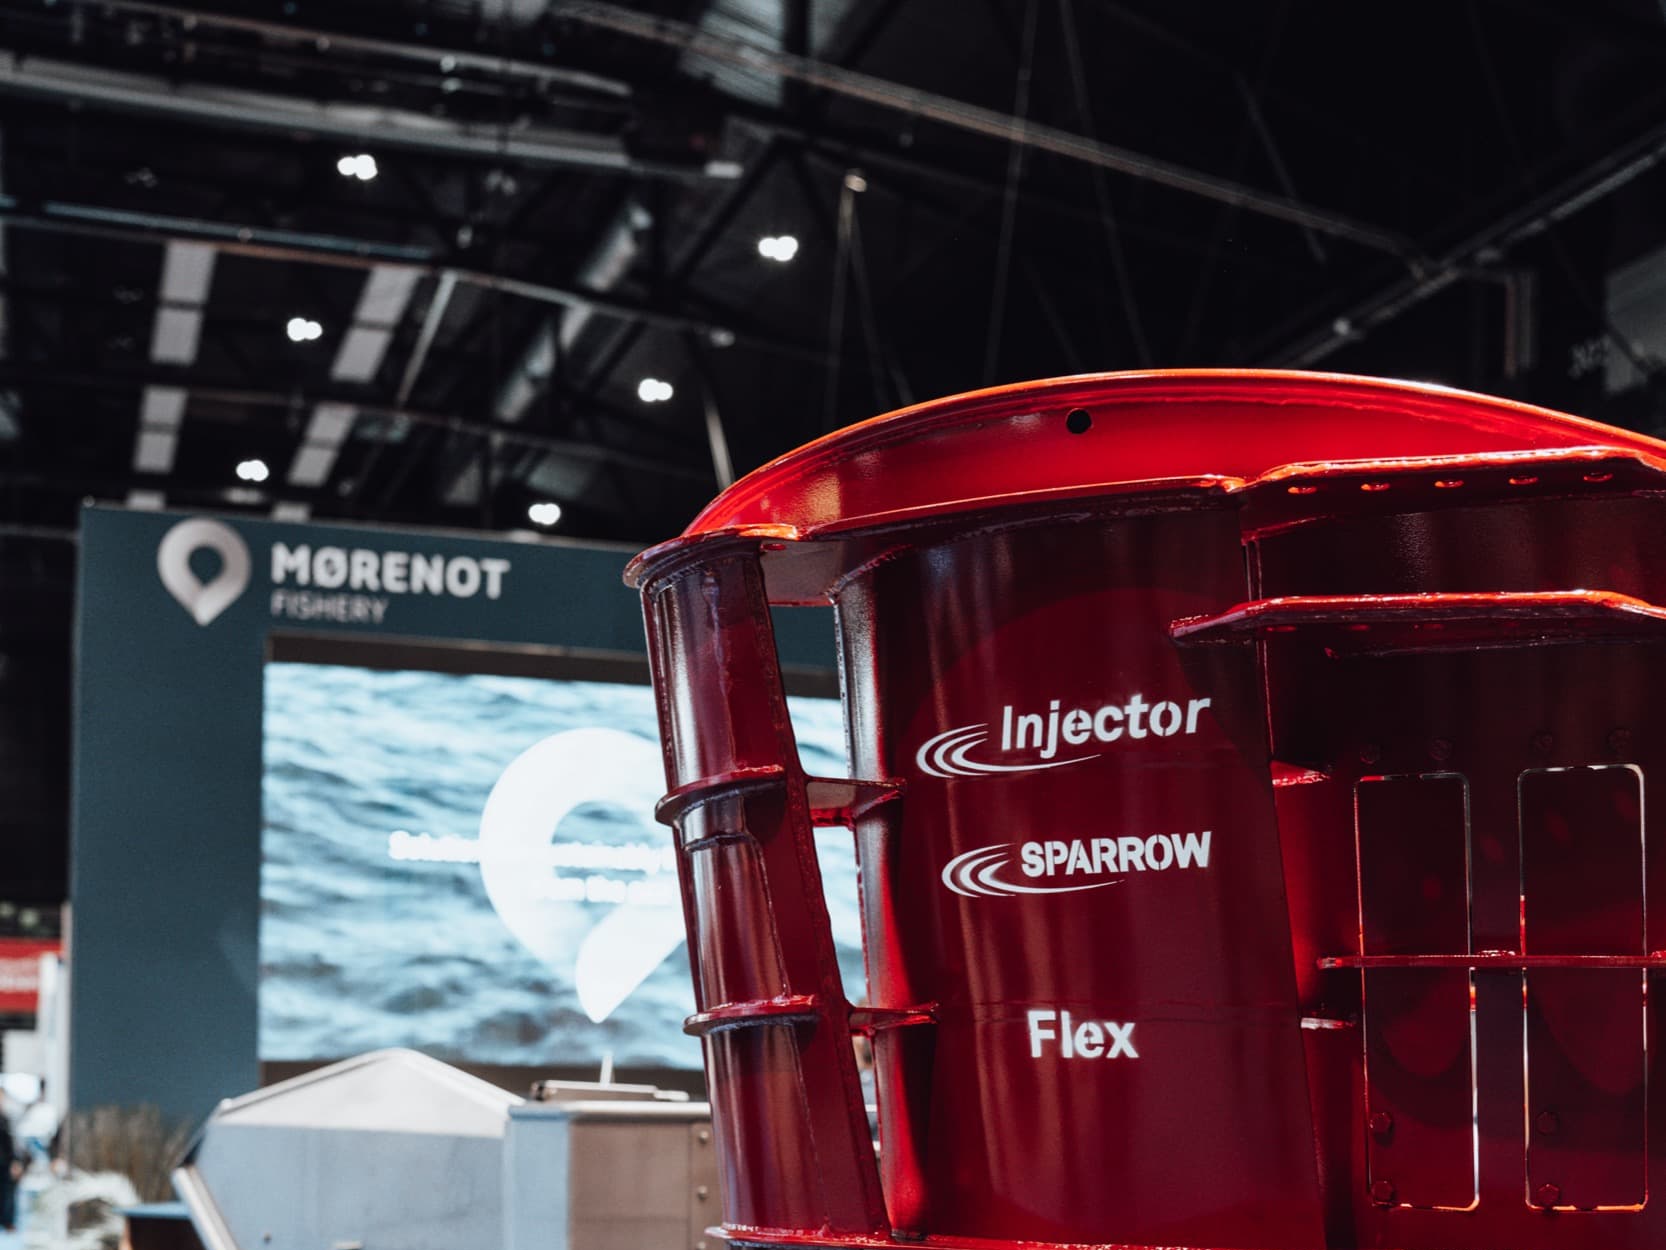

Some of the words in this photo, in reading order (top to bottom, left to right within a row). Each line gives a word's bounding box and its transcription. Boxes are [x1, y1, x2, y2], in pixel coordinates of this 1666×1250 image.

[271, 543, 510, 599] MØRENOT
[270, 591, 388, 623] FISHERY
[1001, 693, 1211, 759] Injector
[1020, 830, 1212, 878] SPARROW
[1026, 1009, 1140, 1059] Flex
